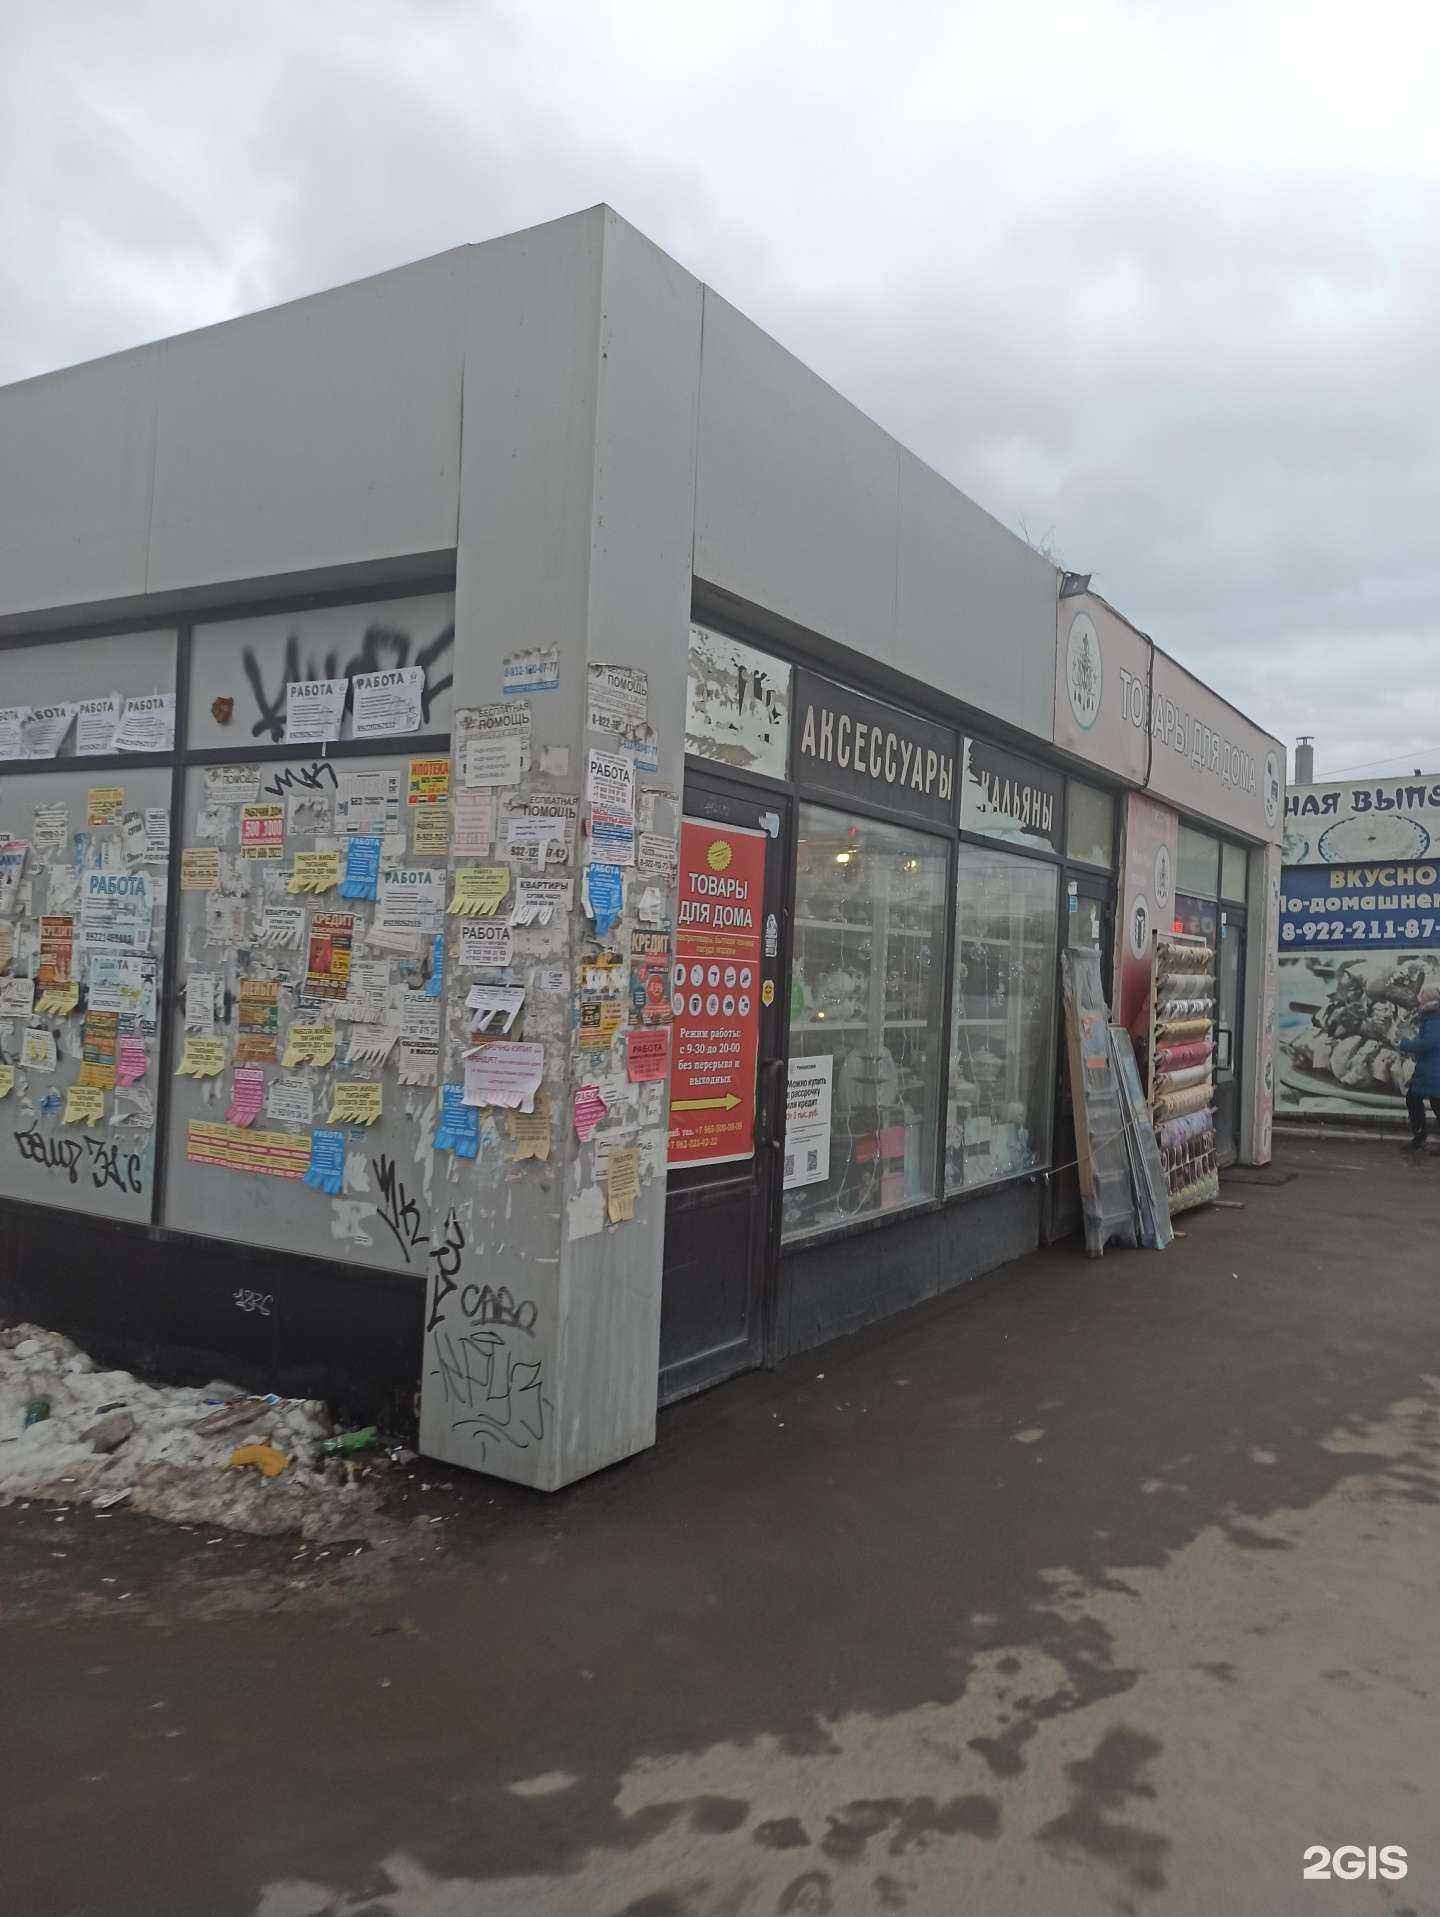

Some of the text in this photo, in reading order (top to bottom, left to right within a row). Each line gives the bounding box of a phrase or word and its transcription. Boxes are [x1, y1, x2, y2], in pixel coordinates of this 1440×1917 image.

[356, 673, 405, 690] РАБОТА
[608, 675, 647, 696] ПОМОЩЬ
[290, 682, 333, 697] РАБОТА
[80, 701, 114, 714] РАБОТА
[128, 698, 164, 712] РАБОТА
[479, 714, 530, 729] ПОМОЩЬ
[801, 704, 953, 800] АКСЕССУАРЫ
[1191, 720, 1221, 776] ДЛЯ
[1221, 741, 1256, 793] ДОМА
[411, 763, 449, 775] ИПОТЕКА
[590, 761, 631, 782] РАБОТА
[523, 806, 576, 819] ПОМОЩЬ
[350, 837, 380, 846] РАБОТА
[590, 863, 620, 875] РАБОТА
[385, 872, 432, 884] РАБОТА
[1330, 866, 1437, 889] ВКУСНО
[89, 875, 146, 896] РАБОТА
[520, 880, 568, 890] КВАРТИРЫ
[688, 872, 748, 900] ТОВАРЫ
[313, 914, 354, 927] КРЕДИТ
[678, 900, 753, 928] ДЛЯ ДОМА
[462, 926, 511, 940] РАБОТА
[632, 932, 670, 953] КРЕДИТ
[680, 1028, 709, 1038] Режим
[632, 1044, 663, 1054] РАБОТА
[686, 1044, 706, 1054] 9-30
[707, 1046, 717, 1055] до
[718, 1043, 741, 1054] 20-00
[678, 1060, 692, 1070] без
[693, 1061, 733, 1073] перерыва
